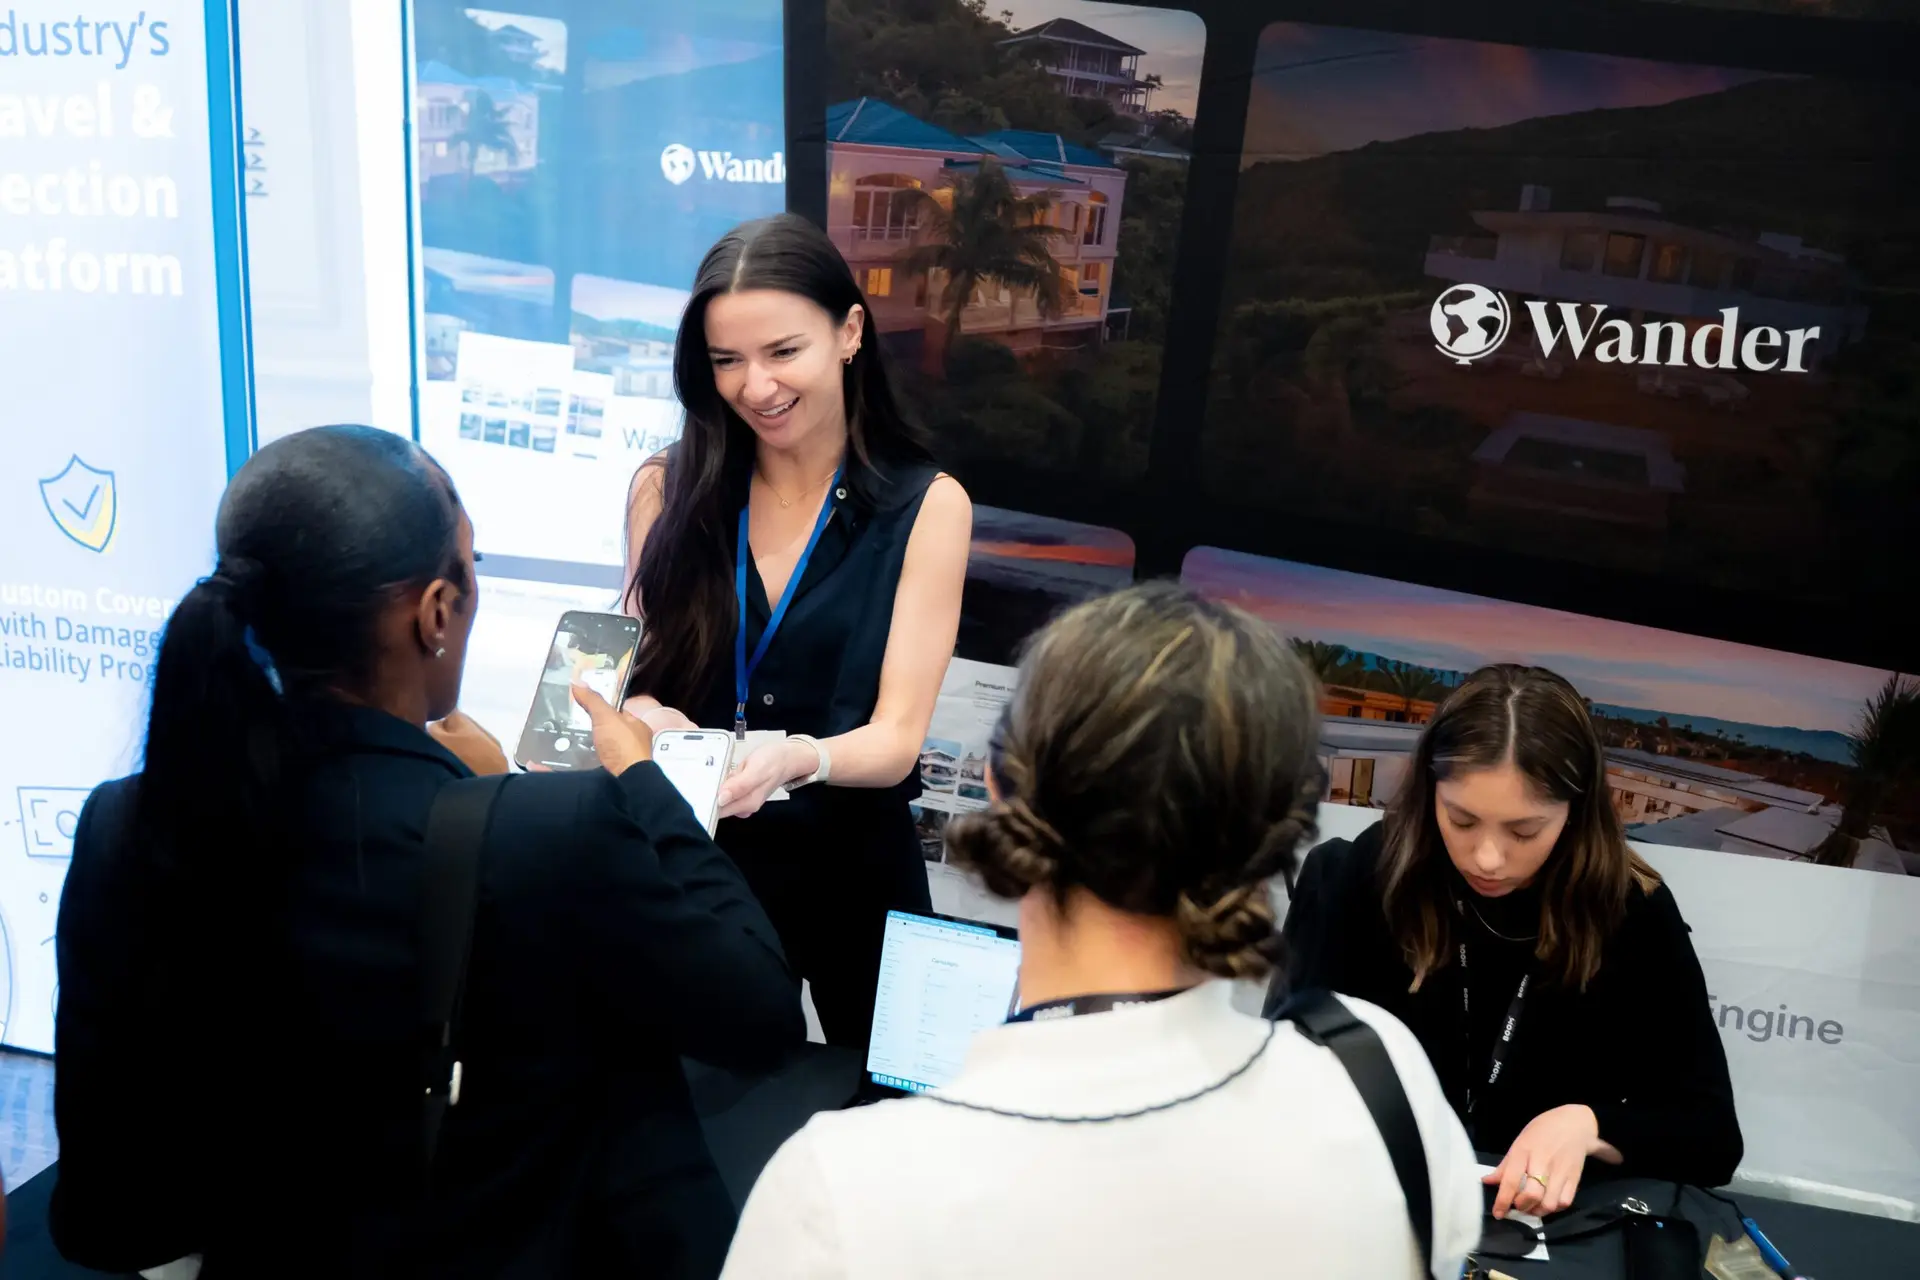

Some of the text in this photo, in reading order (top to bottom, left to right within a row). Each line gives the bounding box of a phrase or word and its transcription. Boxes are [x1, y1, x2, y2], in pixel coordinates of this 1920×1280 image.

[0, 80, 176, 138] avel &
[0, 157, 179, 218] ection
[1525, 300, 1821, 374] Wander
[0, 642, 91, 684] iability
[1502, 1016, 1517, 1042] BOOM
[1488, 1059, 1503, 1084] BOOM
